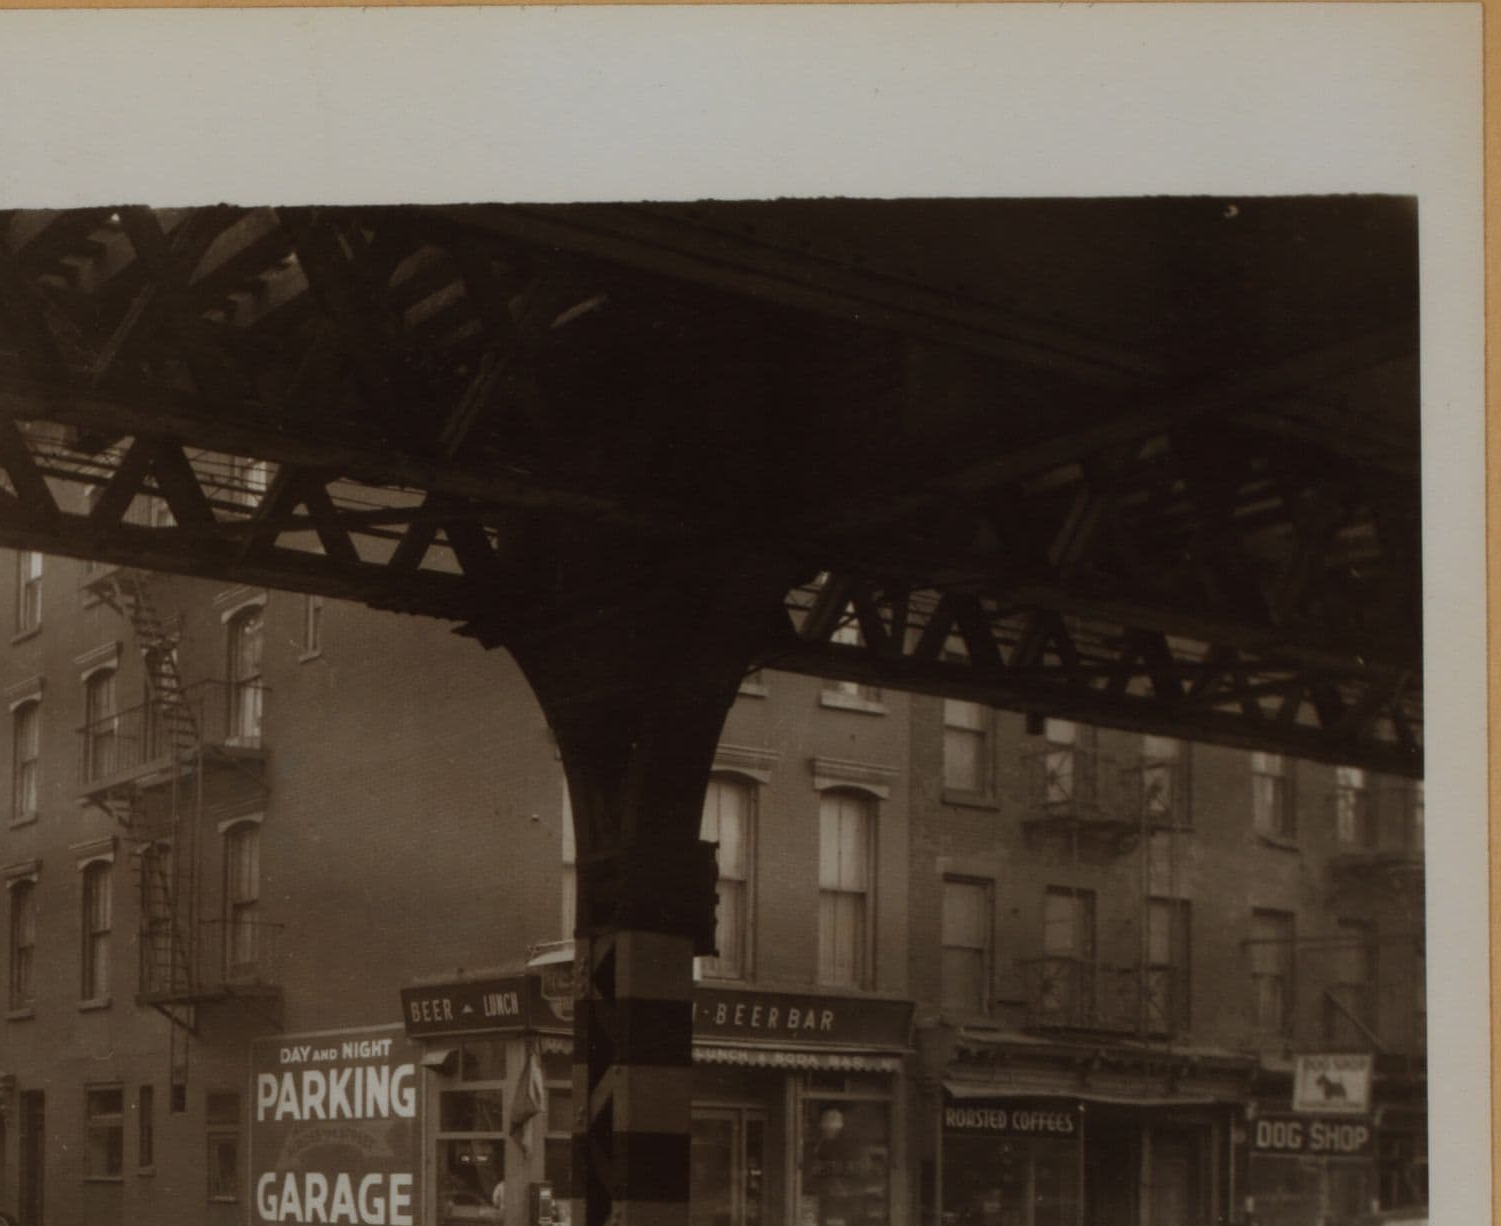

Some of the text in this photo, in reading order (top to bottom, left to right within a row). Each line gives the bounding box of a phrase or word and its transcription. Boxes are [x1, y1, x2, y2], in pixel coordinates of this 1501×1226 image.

[411, 991, 519, 1022] BEER LUNCH
[280, 1039, 393, 1064] DAY AND NIGHT
[257, 1063, 416, 1121] PARKING
[945, 1107, 1074, 1134] ROASTED COFFEES
[1257, 1120, 1369, 1151] DOG SHOP
[257, 1172, 413, 1226] GARAGE
